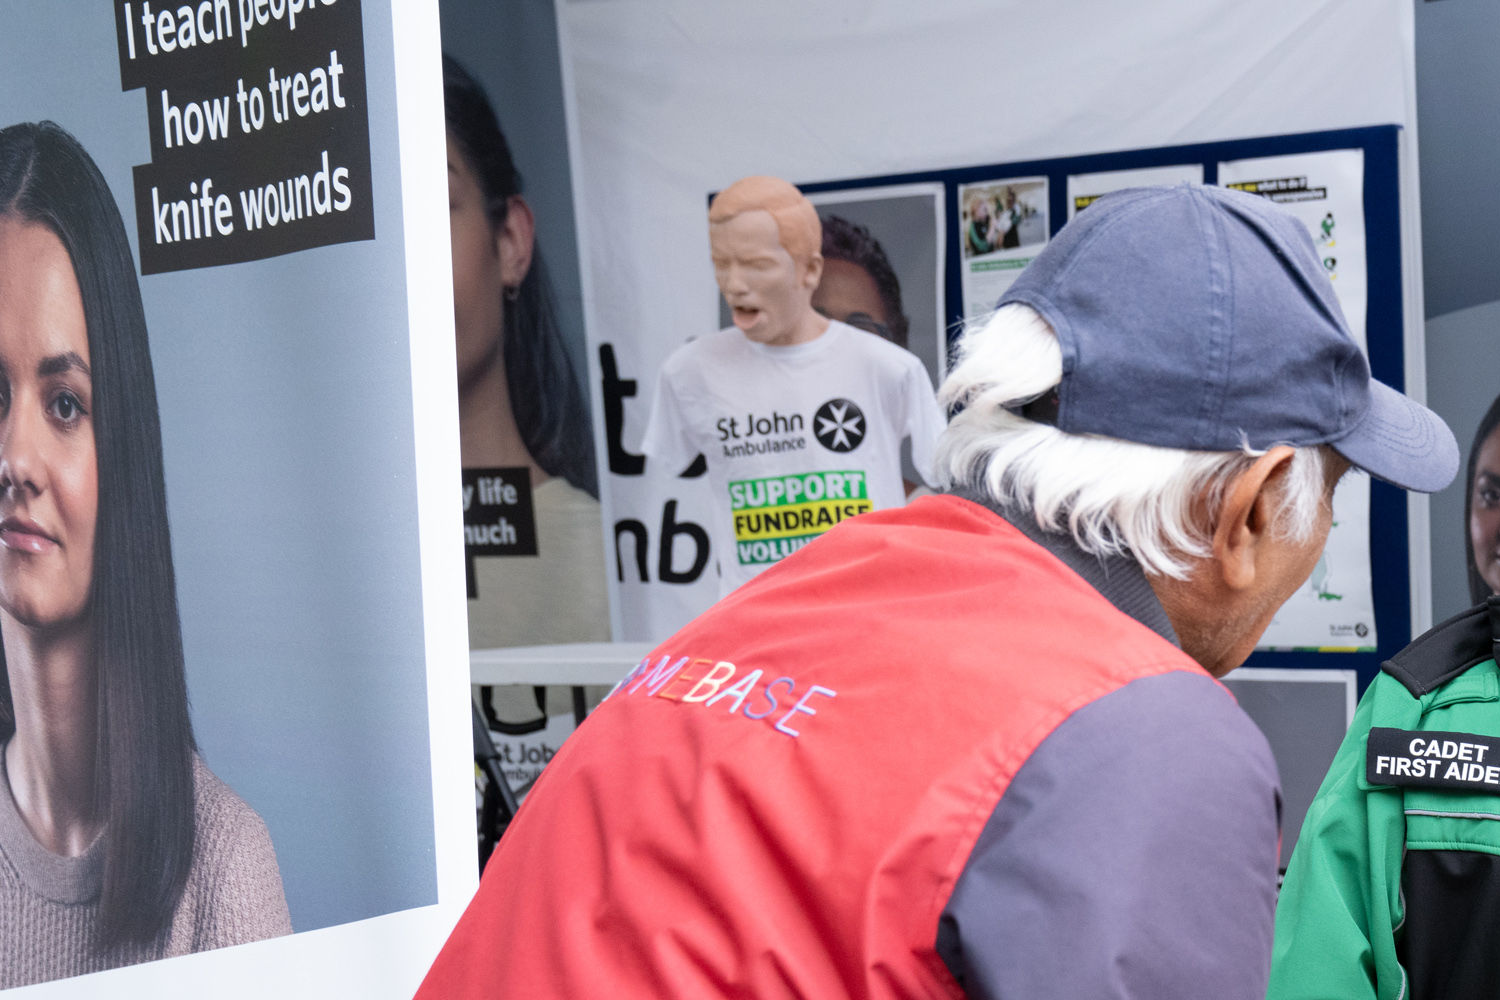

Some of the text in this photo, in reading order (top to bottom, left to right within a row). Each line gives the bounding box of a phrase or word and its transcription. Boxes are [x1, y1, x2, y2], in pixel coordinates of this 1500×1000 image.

[125, 0, 338, 60] I teach peop
[161, 50, 346, 148] how to treat
[152, 150, 352, 244] knife wounds
[717, 411, 803, 441] St John
[722, 437, 806, 458] Ambulance
[477, 476, 518, 506] life
[731, 473, 863, 509] SUPPORT
[602, 655, 837, 738] MEBASE
[1376, 756, 1441, 778] FIRST
[1409, 738, 1489, 763] CADET
